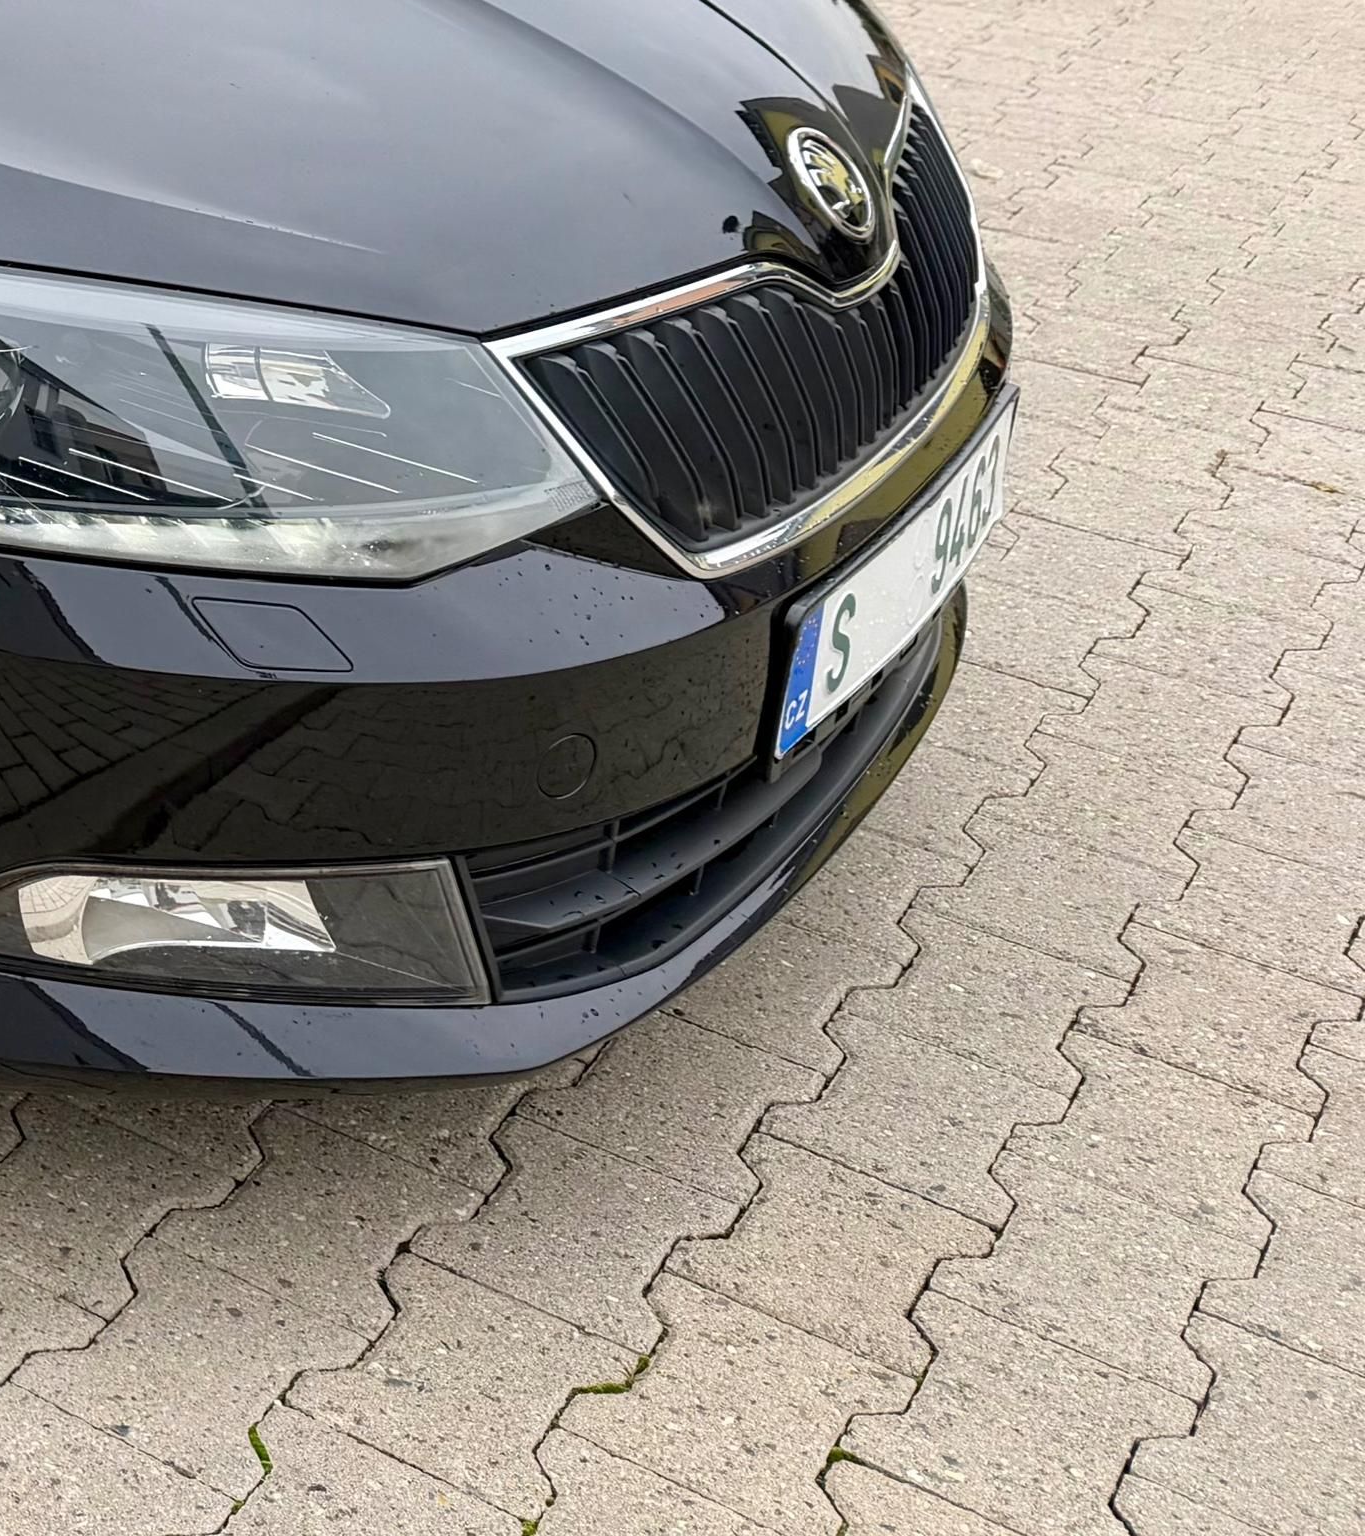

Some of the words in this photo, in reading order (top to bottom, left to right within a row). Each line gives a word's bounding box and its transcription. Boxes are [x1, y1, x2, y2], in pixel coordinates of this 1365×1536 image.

[826, 592, 856, 693] S
[931, 434, 1000, 595] 9463
[785, 689, 809, 730] CZ
